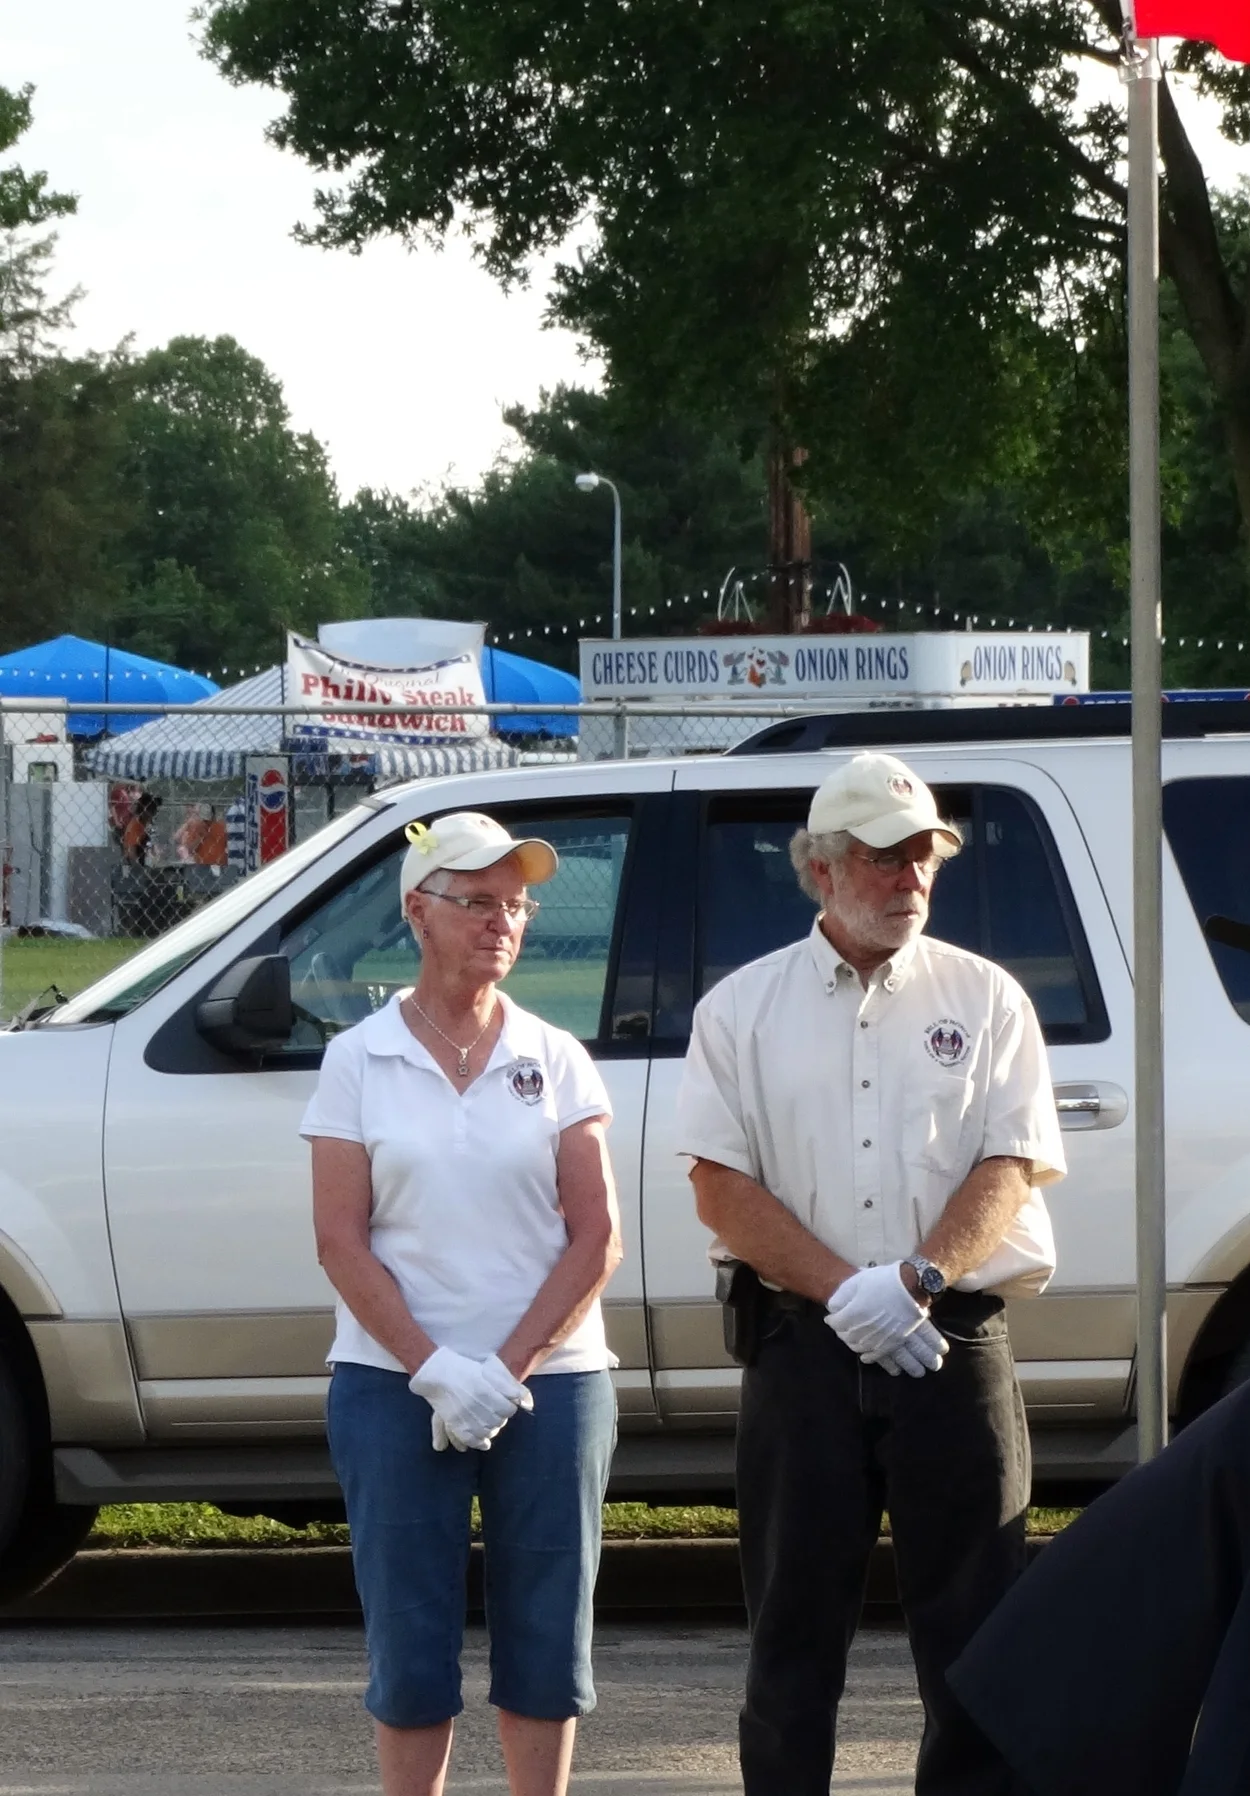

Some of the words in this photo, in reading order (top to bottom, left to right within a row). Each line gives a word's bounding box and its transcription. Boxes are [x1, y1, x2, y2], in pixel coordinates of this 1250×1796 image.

[592, 650, 659, 685] CHEESE
[664, 649, 720, 684] CURDS
[795, 648, 849, 682] ONION
[856, 646, 909, 681] RINGS
[974, 645, 1016, 681] ONION
[1022, 645, 1062, 680] RINGS
